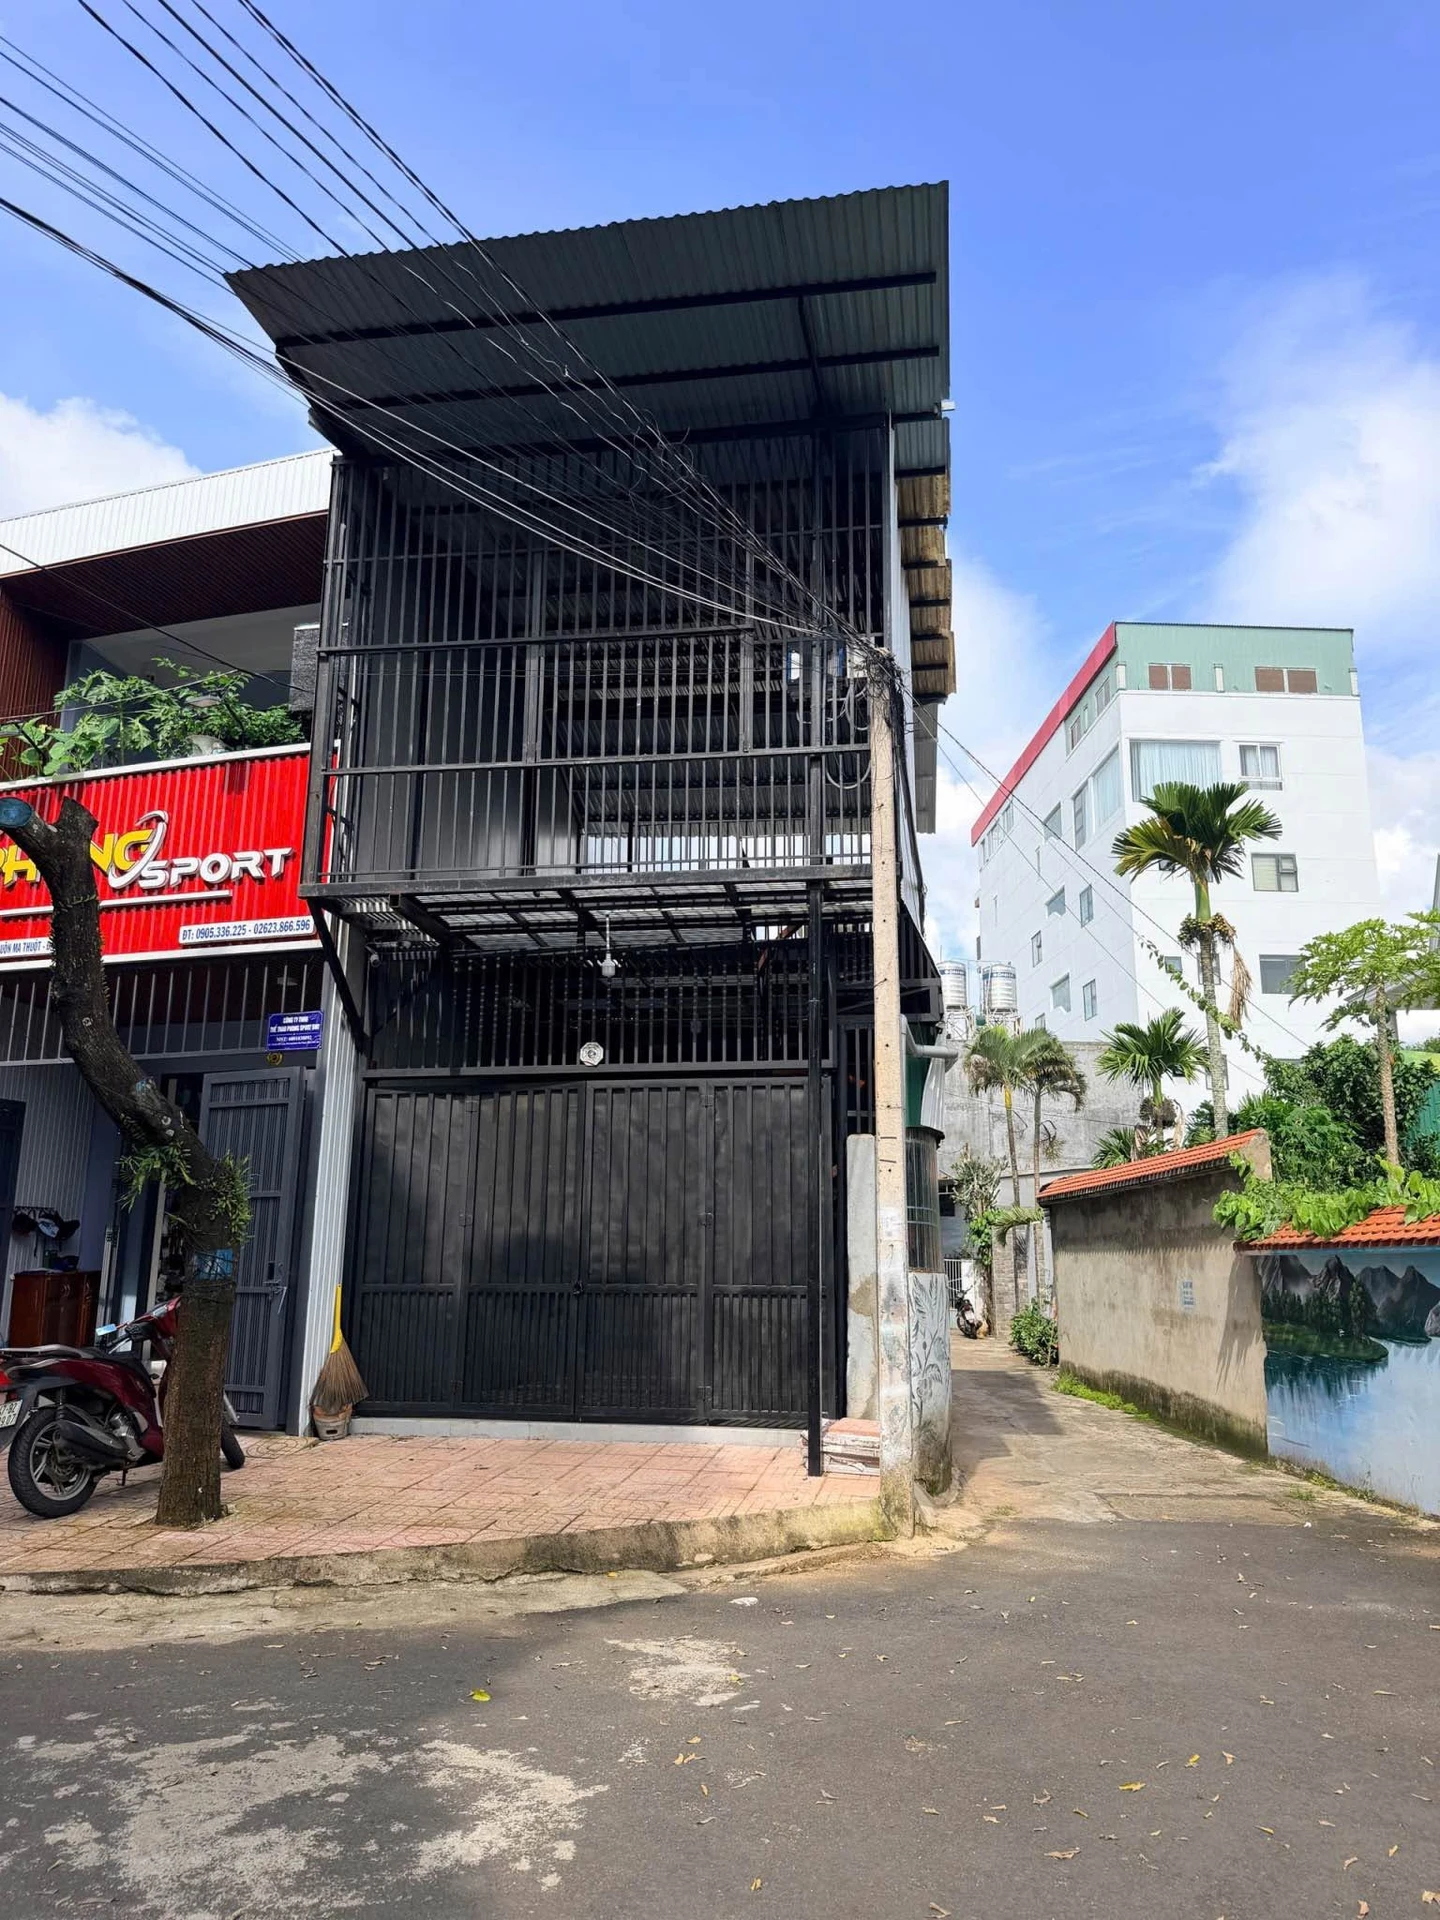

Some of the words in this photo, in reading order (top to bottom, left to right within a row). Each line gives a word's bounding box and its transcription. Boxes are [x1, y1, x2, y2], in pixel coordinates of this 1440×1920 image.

[0, 829, 154, 886] HNG
[138, 847, 293, 889] SPORT
[182, 929, 194, 940] ĐT:
[195, 924, 247, 939] 0905.336.225
[253, 919, 311, 934] 02623.866.596
